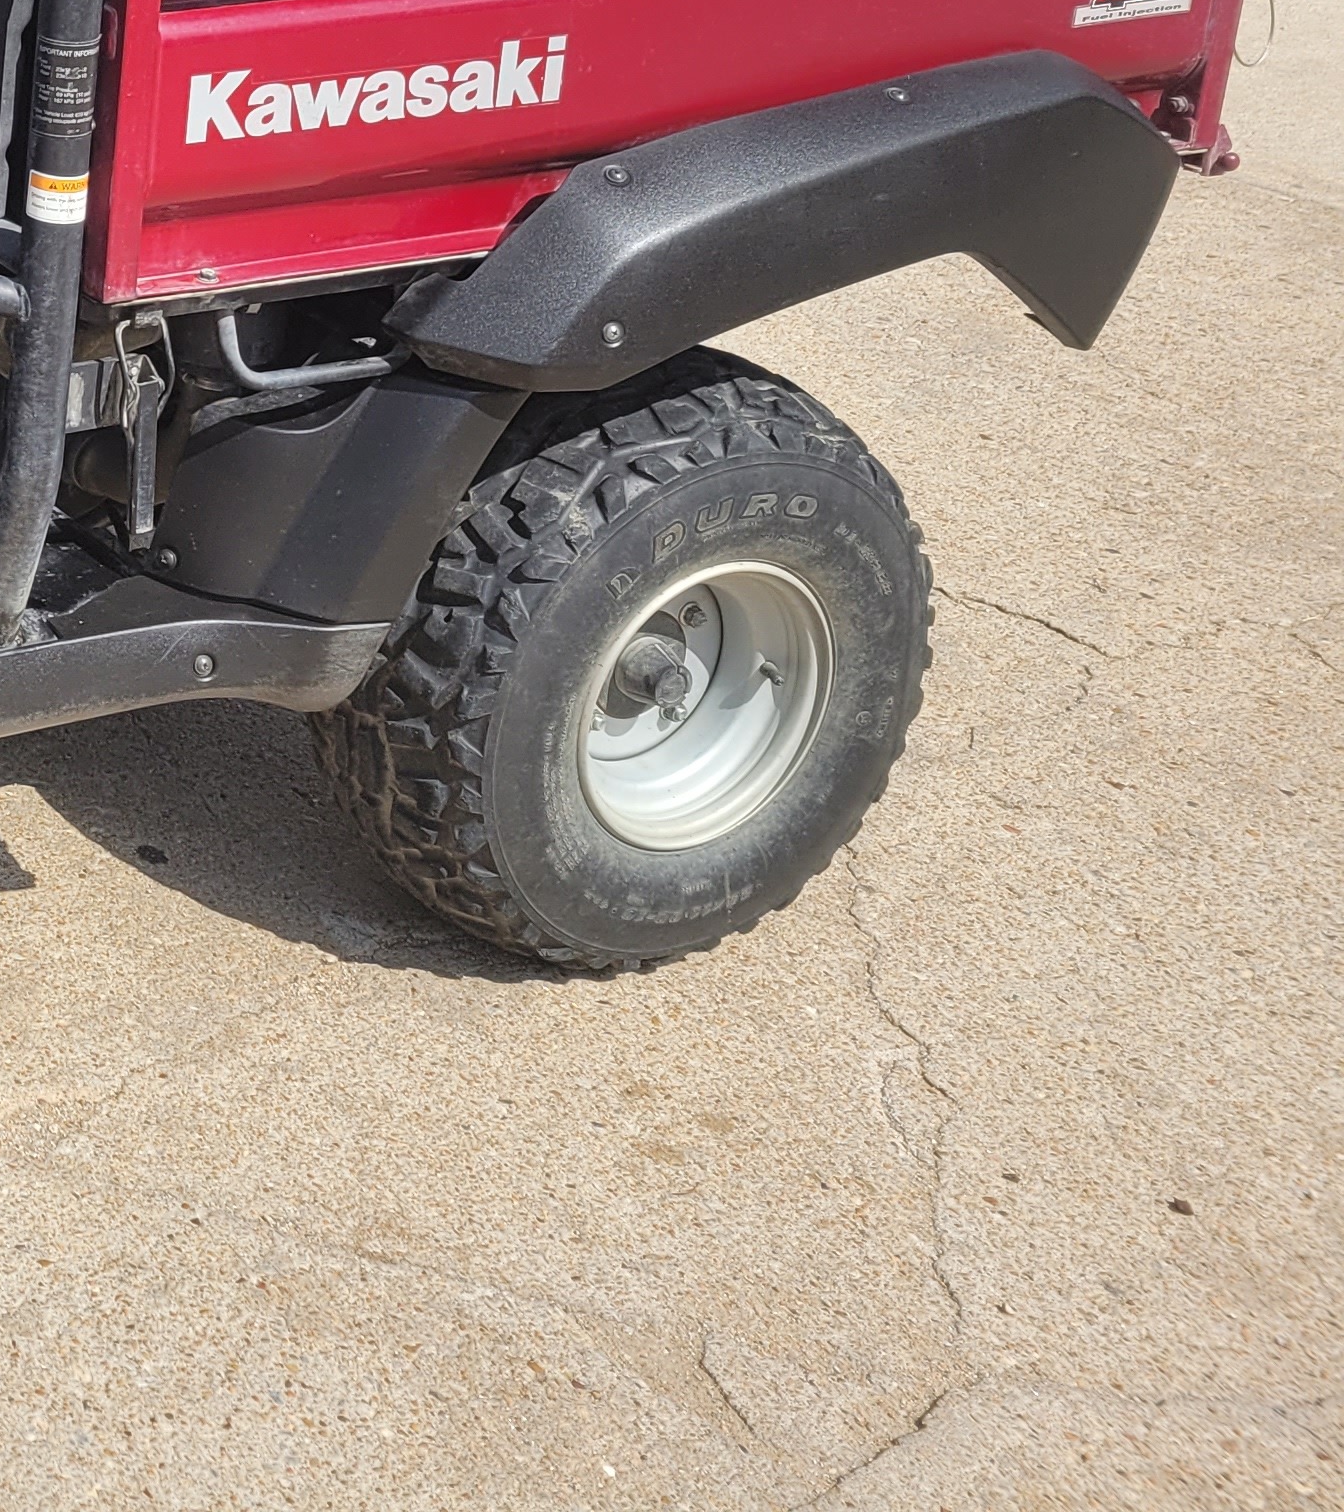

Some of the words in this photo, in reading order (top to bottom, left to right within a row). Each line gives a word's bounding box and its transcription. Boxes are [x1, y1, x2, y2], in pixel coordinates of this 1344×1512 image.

[1081, 11, 1113, 24] Fuel
[1118, 2, 1182, 19] Injection
[184, 34, 568, 145] Kawasaki
[651, 491, 819, 565] DURO
